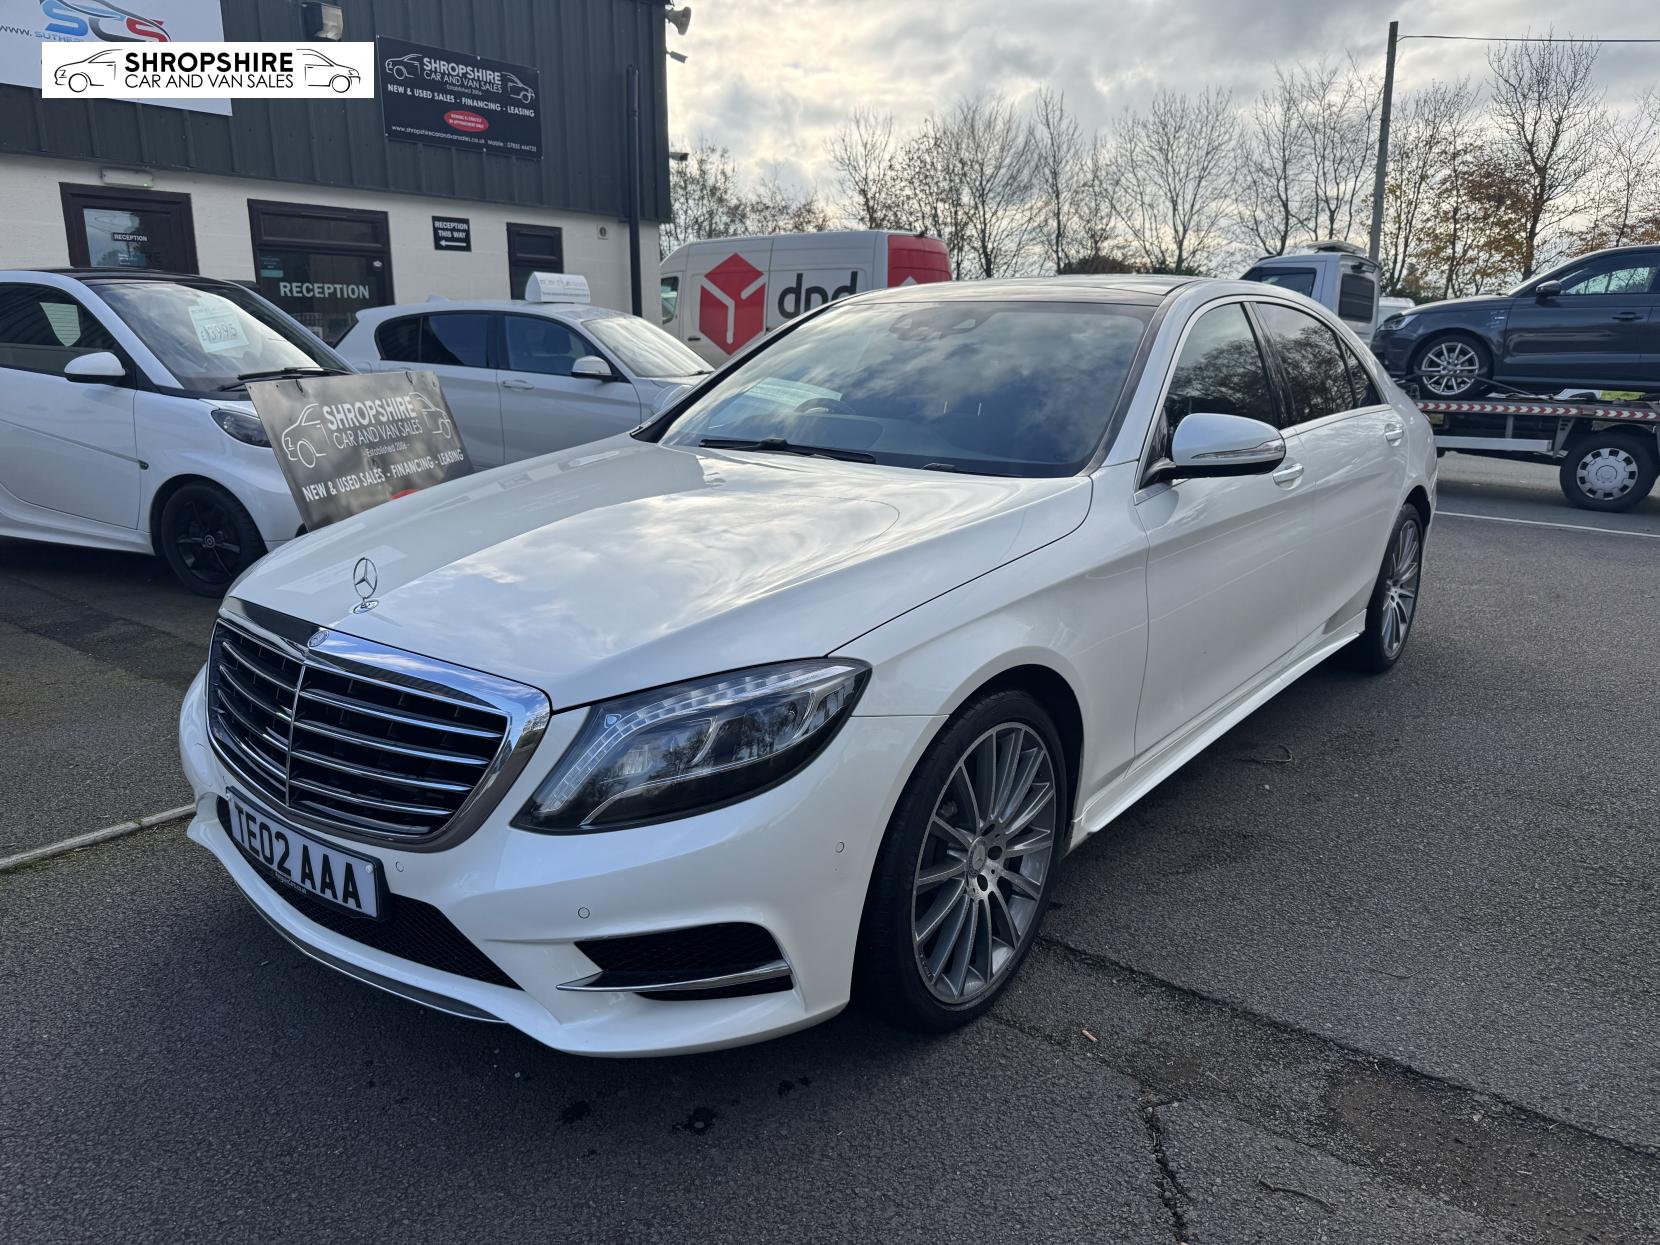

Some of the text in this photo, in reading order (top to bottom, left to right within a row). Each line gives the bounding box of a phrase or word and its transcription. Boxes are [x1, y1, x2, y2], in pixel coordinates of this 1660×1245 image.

[423, 57, 502, 84] SHROPSHIRE
[424, 71, 502, 93] CAR AND VAN SALES
[388, 84, 405, 94] NEW
[414, 89, 432, 99] USED
[434, 92, 455, 103] SALES
[462, 97, 501, 111] FINANCING
[508, 105, 535, 117] LEASING
[114, 234, 148, 242] RECEPTION
[435, 221, 468, 230] RECEPTION
[438, 230, 452, 238] THIS
[279, 281, 370, 300] RECEPTION
[323, 395, 417, 430] SHROPSHIRE
[333, 419, 423, 450] CAR AND VAN SALES
[302, 482, 328, 502] NEW
[329, 481, 337, 496] &
[338, 475, 360, 492] USED
[361, 468, 386, 487] SALES
[390, 456, 434, 479] FINANCING
[438, 449, 464, 466] LEASING
[234, 800, 362, 910] TE02 AAA
